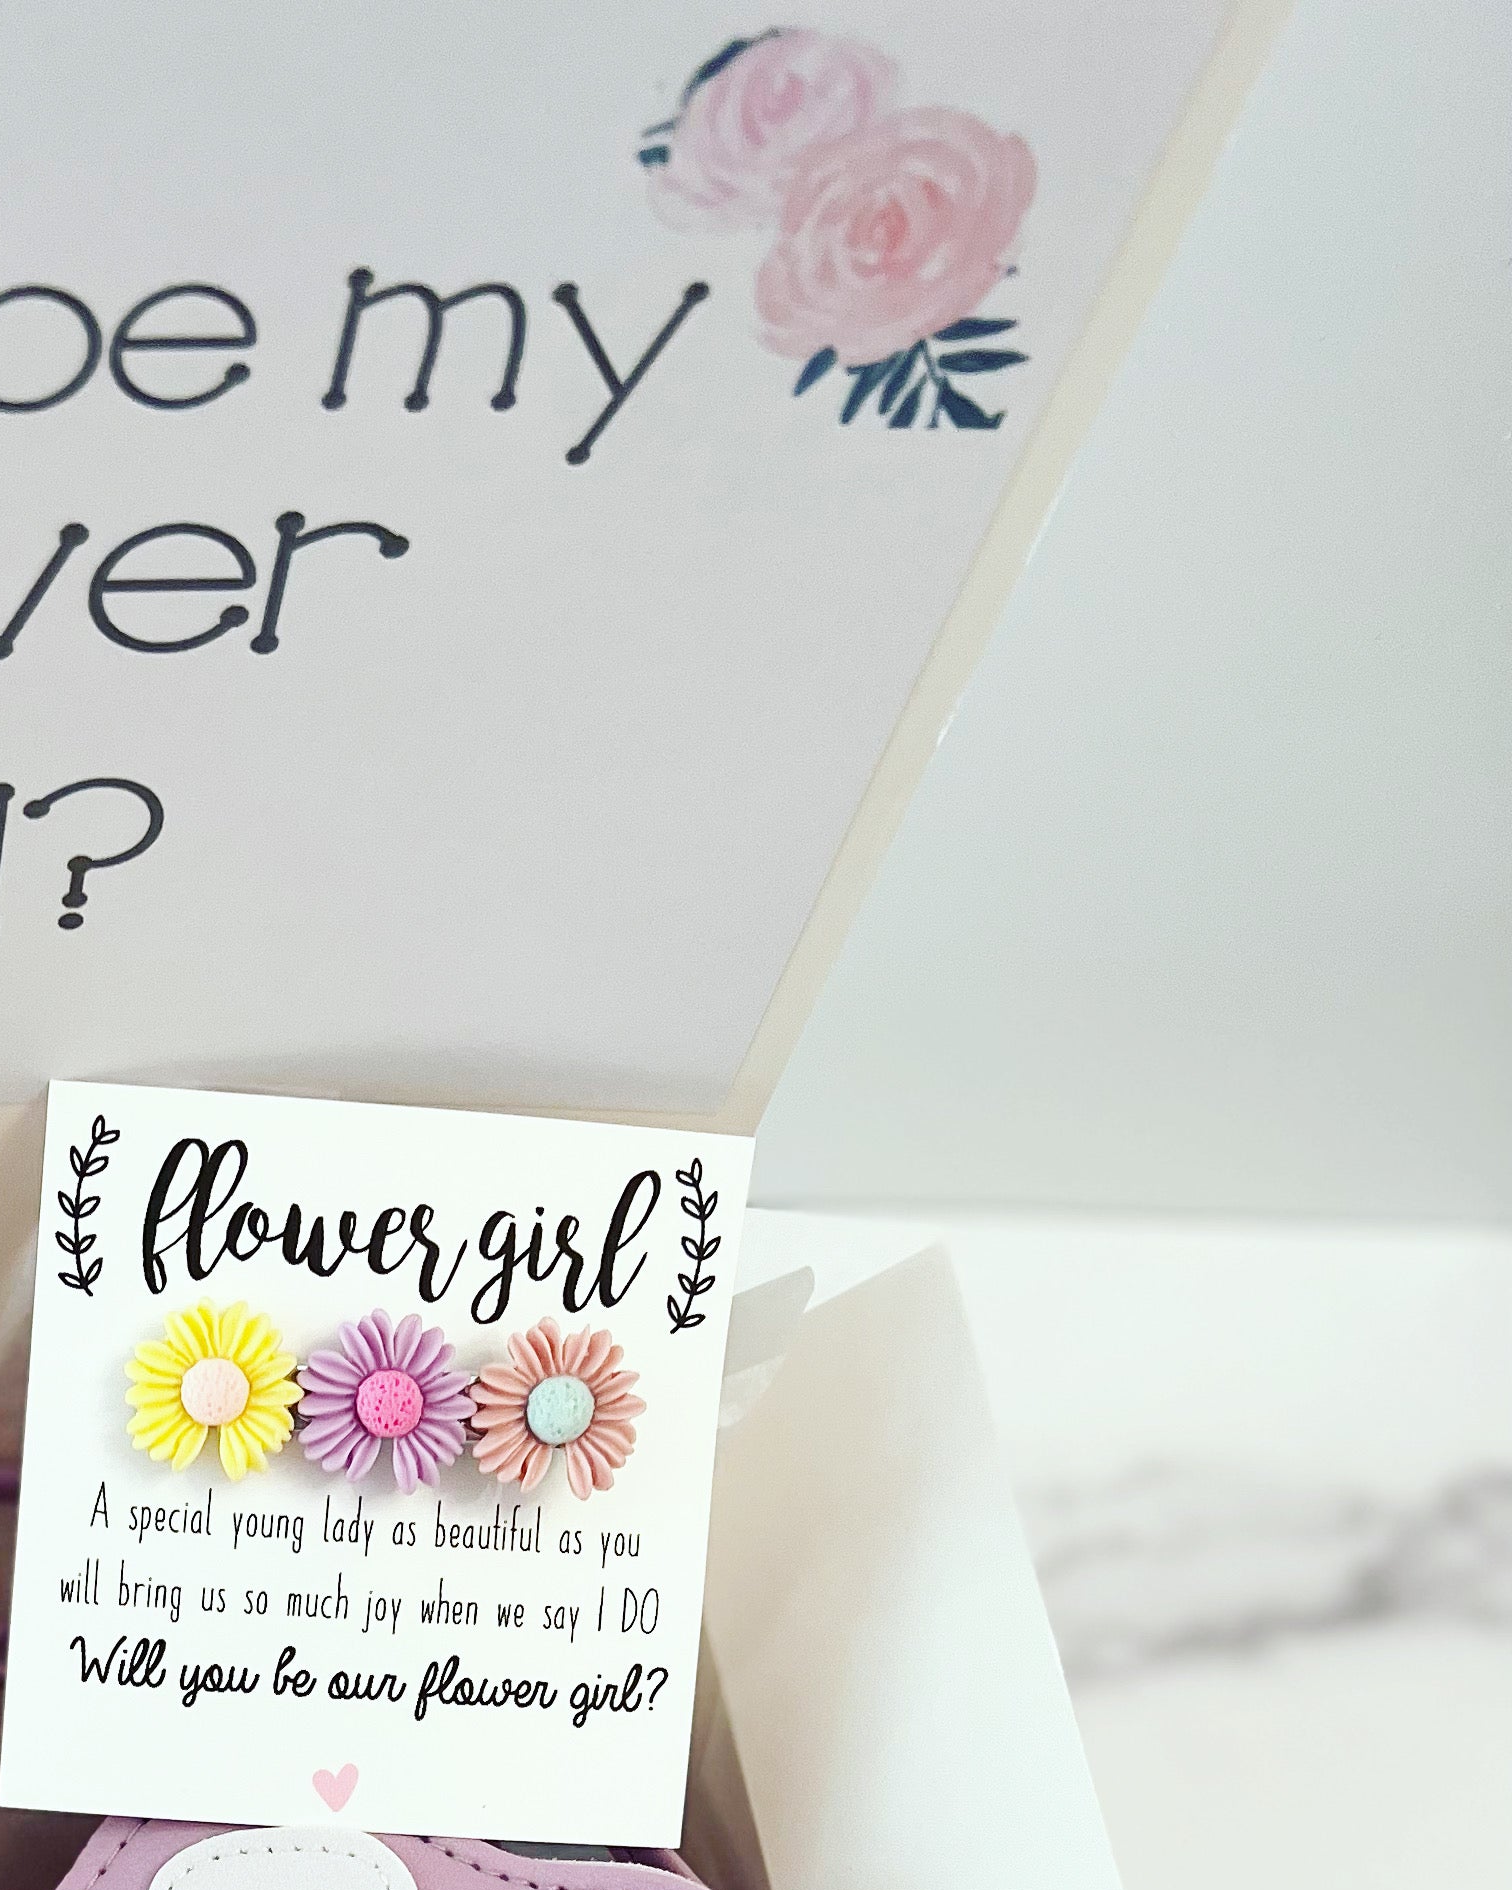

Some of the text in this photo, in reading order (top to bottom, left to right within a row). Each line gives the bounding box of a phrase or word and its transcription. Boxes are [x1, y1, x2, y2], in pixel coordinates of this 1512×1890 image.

[322, 268, 709, 465] my
[143, 1138, 661, 1324] flower girl
[90, 1482, 639, 1568] A special young lady as beautiful as you
[61, 1558, 659, 1643] will bring us so much joy when we say I DO
[70, 1636, 668, 1728] Will you be our flower girl?
